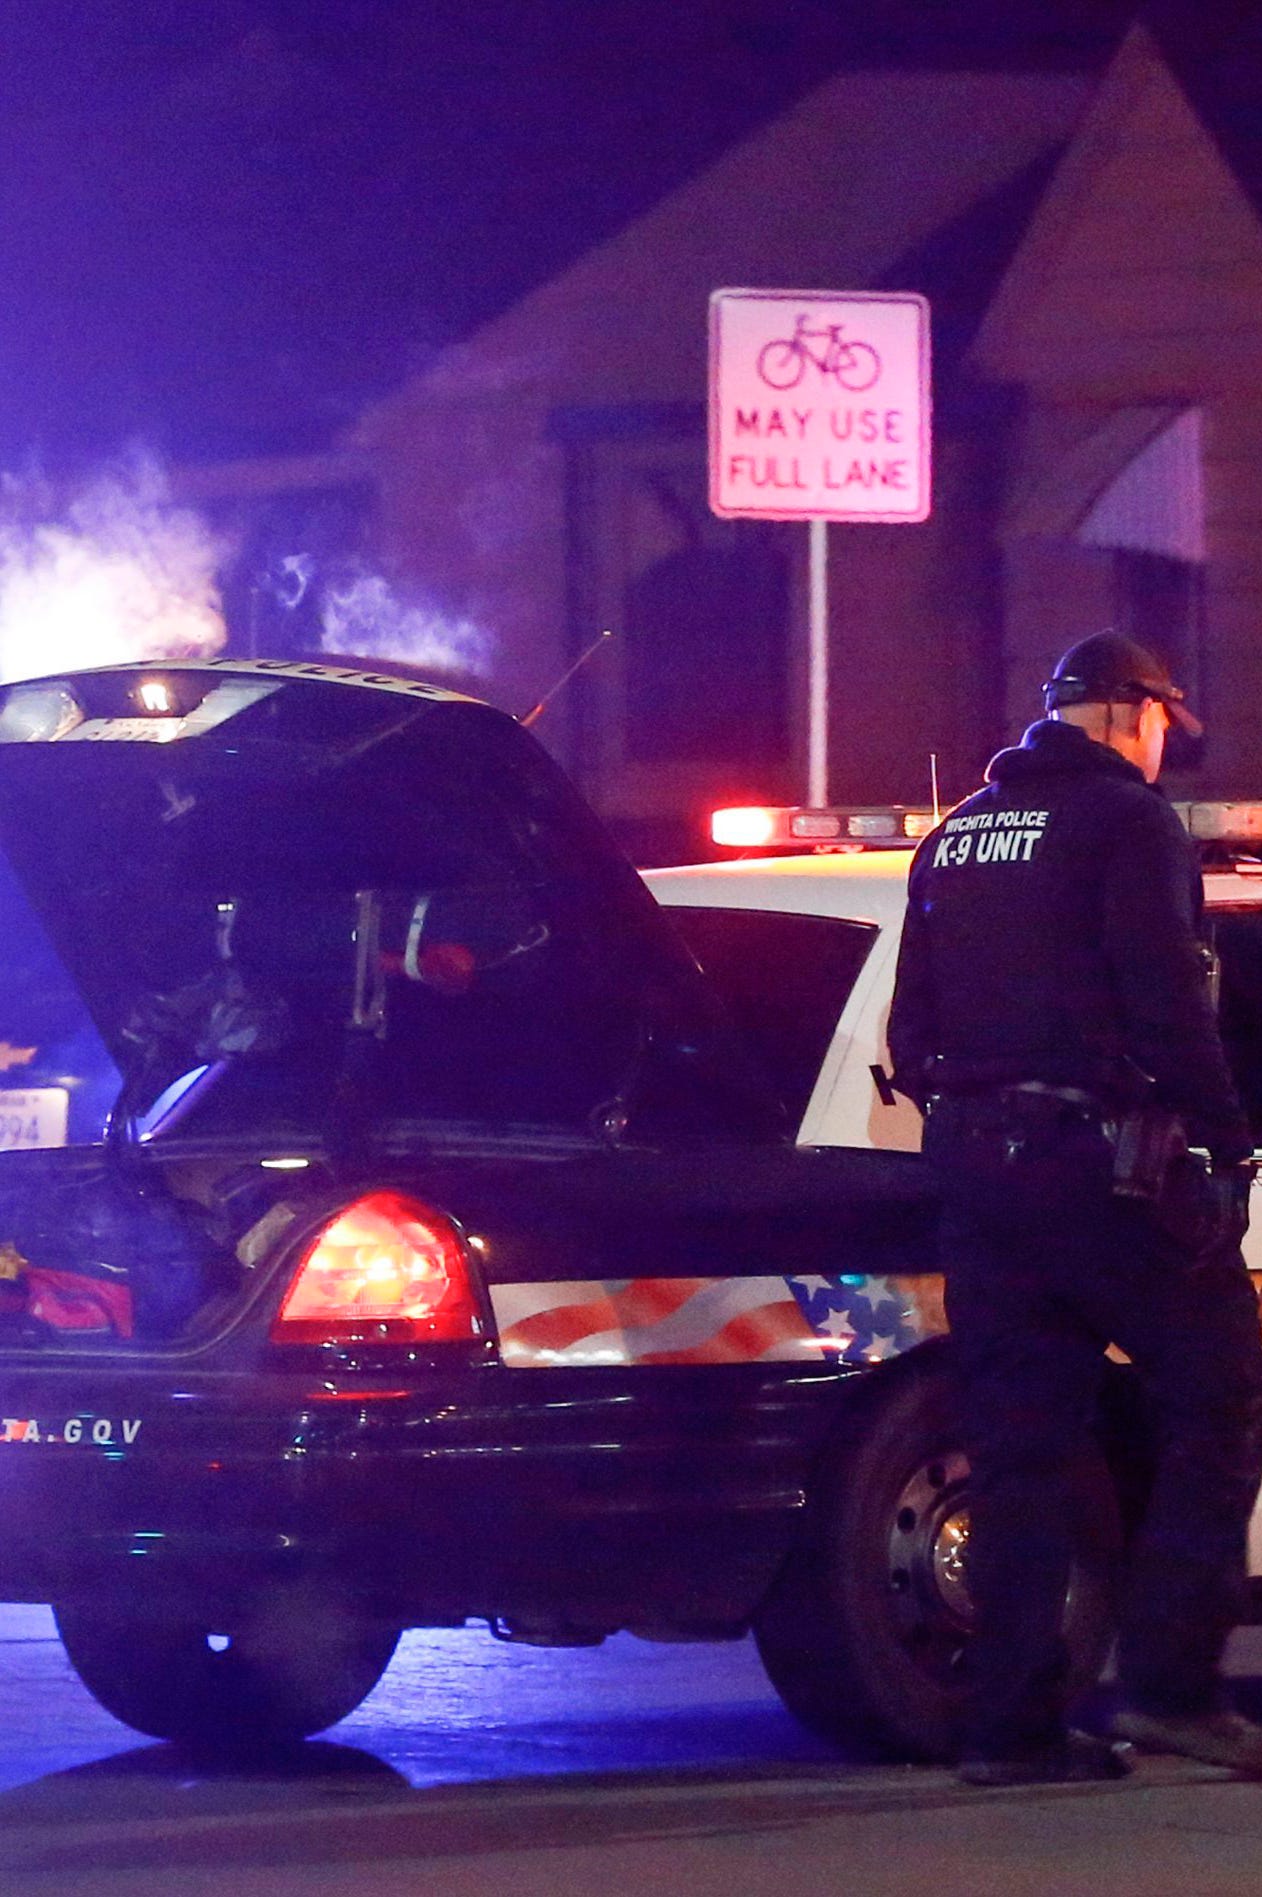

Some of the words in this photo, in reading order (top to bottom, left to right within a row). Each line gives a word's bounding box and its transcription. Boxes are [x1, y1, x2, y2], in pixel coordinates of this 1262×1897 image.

[736, 408, 812, 438] MAY
[831, 409, 901, 443] USE
[729, 454, 808, 490] FULL
[824, 457, 910, 490] LANE
[945, 813, 994, 834] WICHITA
[995, 810, 1049, 828] POLICE
[932, 835, 973, 868] K-9
[976, 830, 1043, 863] UNIT
